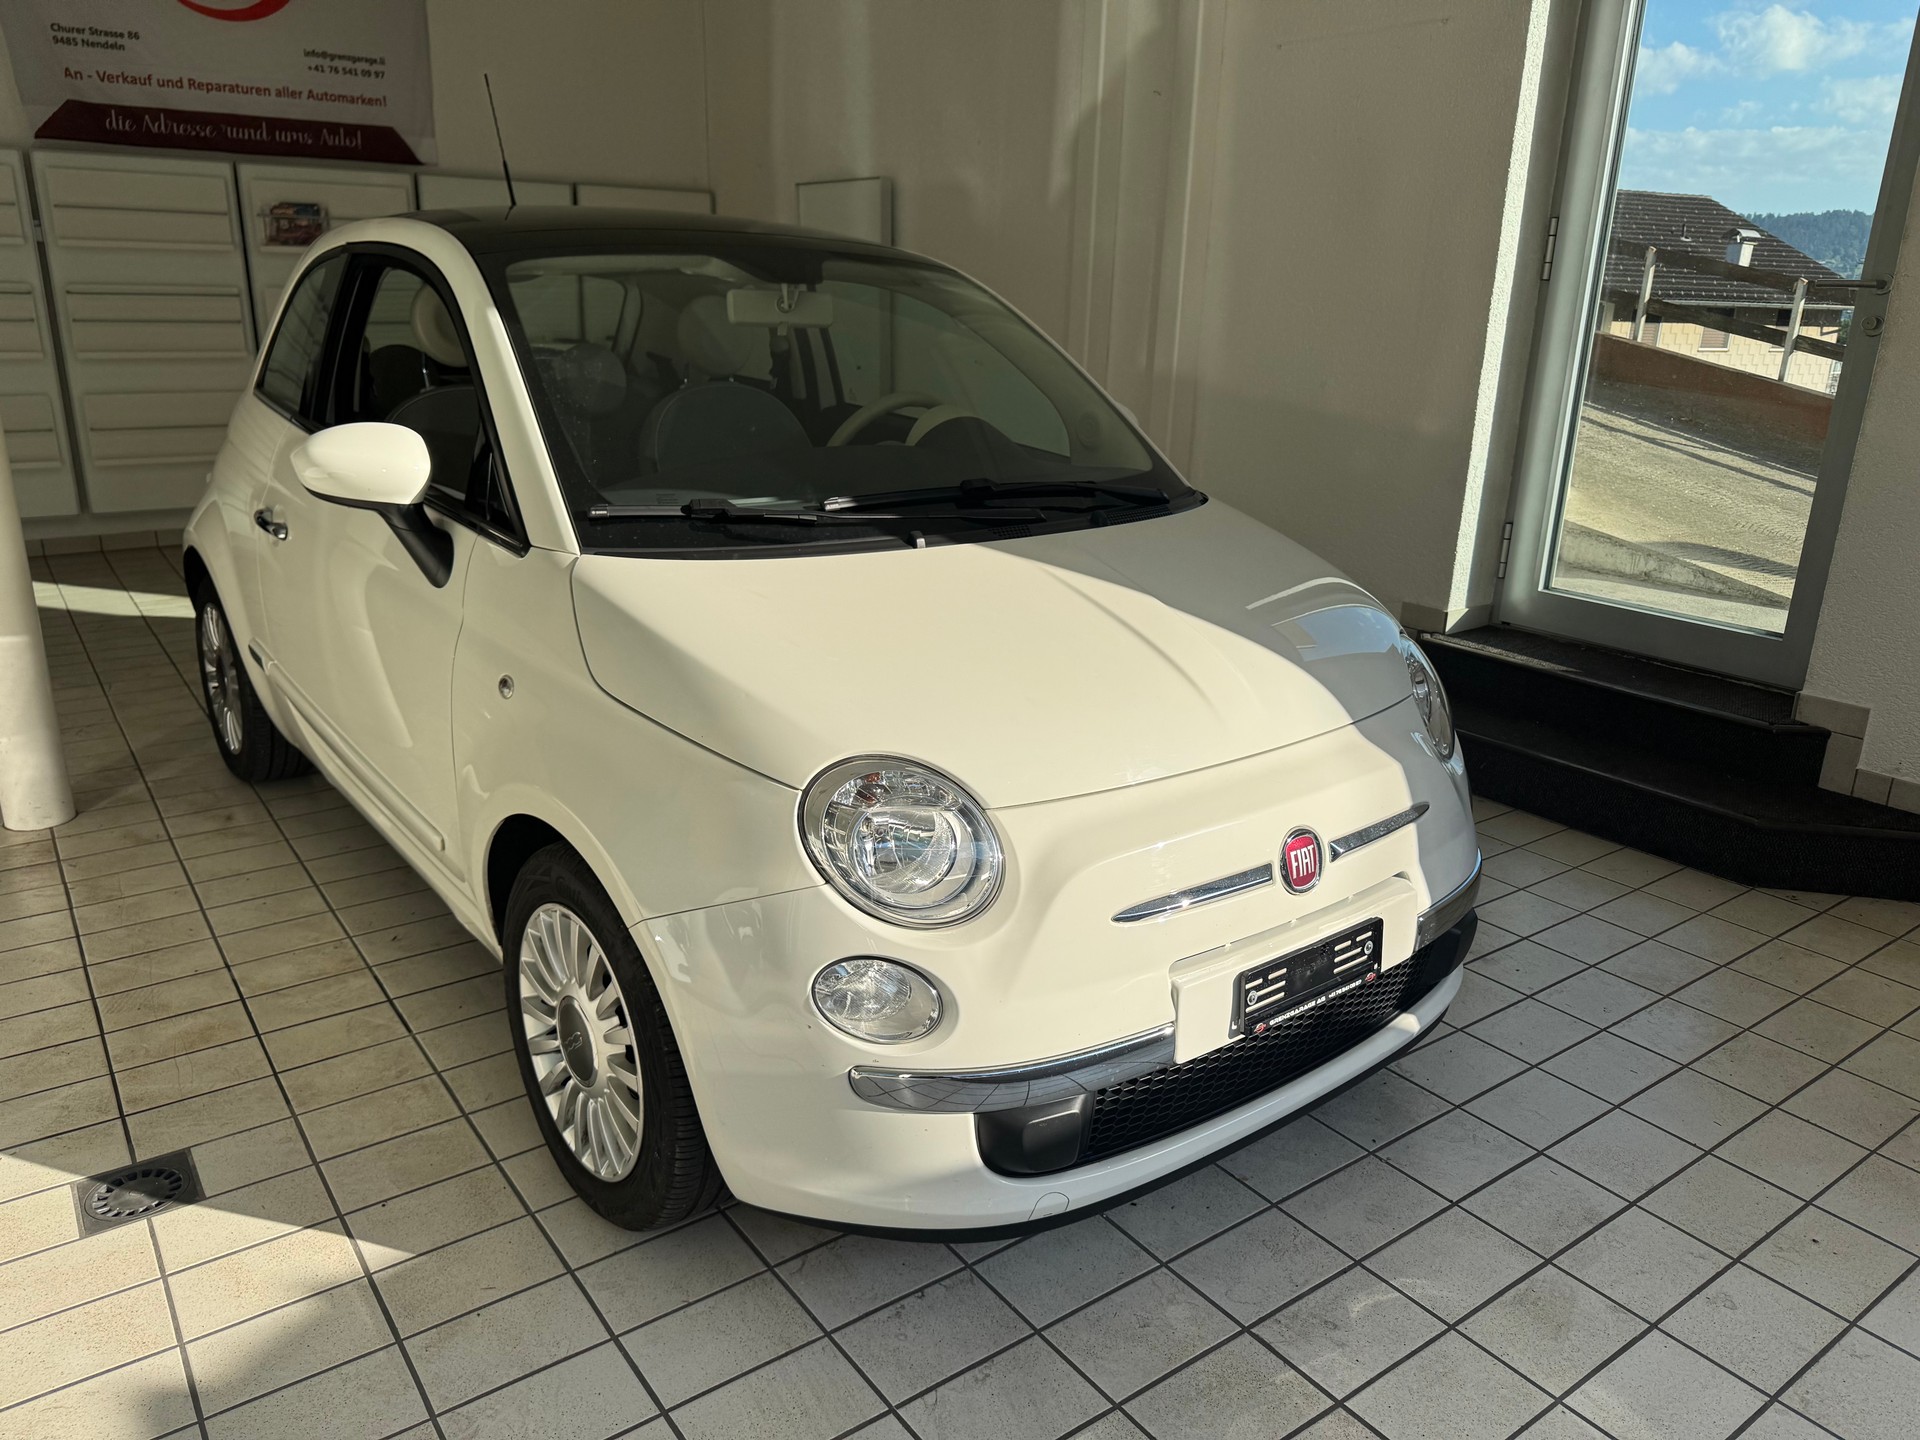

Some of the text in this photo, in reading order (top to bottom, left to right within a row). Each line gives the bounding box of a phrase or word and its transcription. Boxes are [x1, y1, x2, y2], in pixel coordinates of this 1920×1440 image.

[50, 22, 140, 40] Churer Strasse 86
[52, 35, 126, 51] 9485 Nendeln
[328, 65, 340, 75] 76
[341, 66, 358, 77] 541
[64, 66, 84, 80] An
[95, 70, 153, 87] Verkauf
[156, 76, 184, 90] und
[188, 78, 271, 98] Reparaturen
[275, 85, 303, 100] aller
[306, 89, 387, 108] Automarken!
[105, 108, 362, 149] die Adresse rund ums Auto!
[1290, 844, 1314, 879] FIAT
